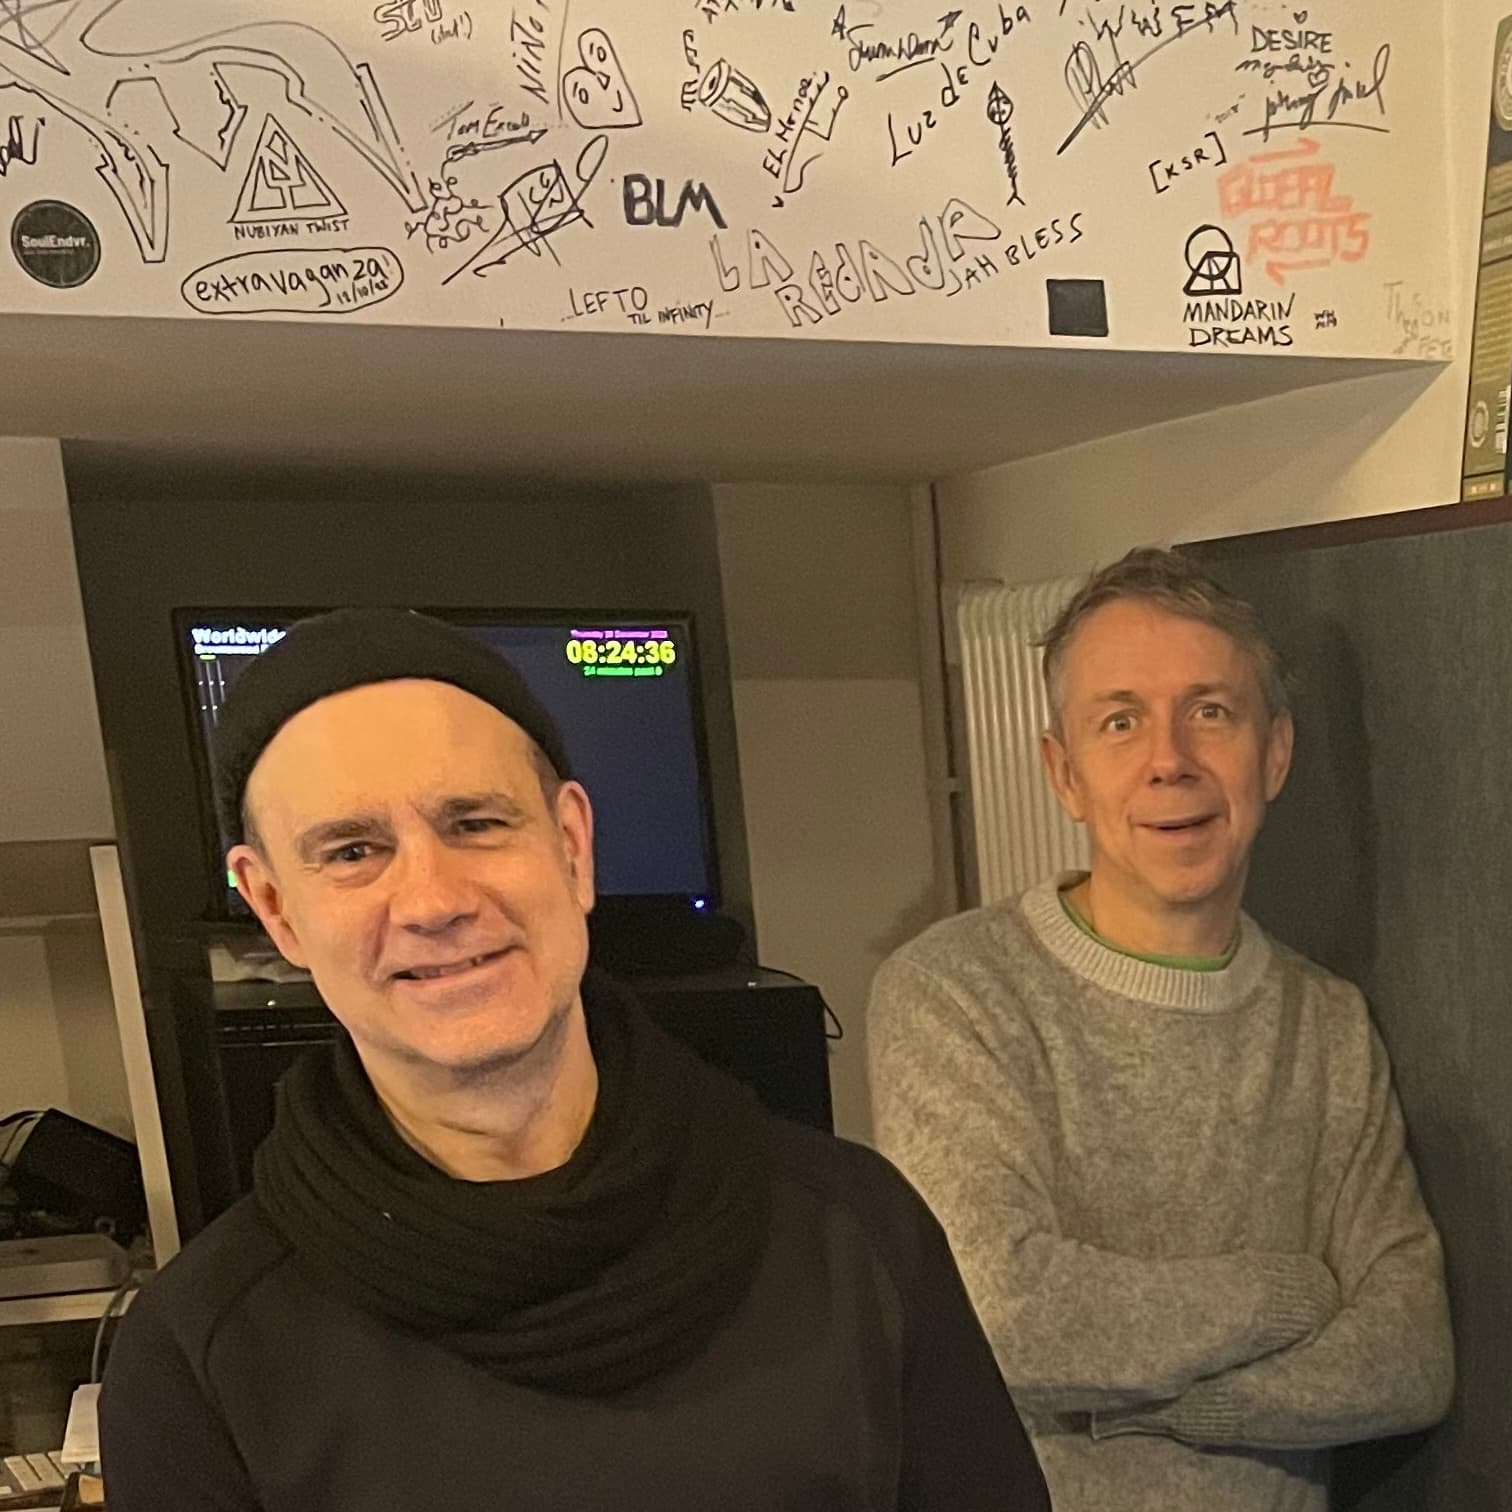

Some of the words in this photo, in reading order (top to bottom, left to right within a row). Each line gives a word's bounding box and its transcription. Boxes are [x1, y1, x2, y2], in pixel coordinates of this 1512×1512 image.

[1251, 25, 1333, 53] DESIRE
[622, 174, 728, 229] BLM
[234, 223, 299, 241] NUBIYAN
[306, 219, 349, 234] TWIST
[946, 254, 999, 297] JAH
[1005, 212, 1082, 266] BLESS
[658, 300, 713, 329] INFINITY
[1183, 292, 1295, 323] MANDARIN
[1188, 325, 1293, 347] DREAMS
[191, 627, 286, 644] Worldwid
[566, 640, 676, 664] 08:24:36
